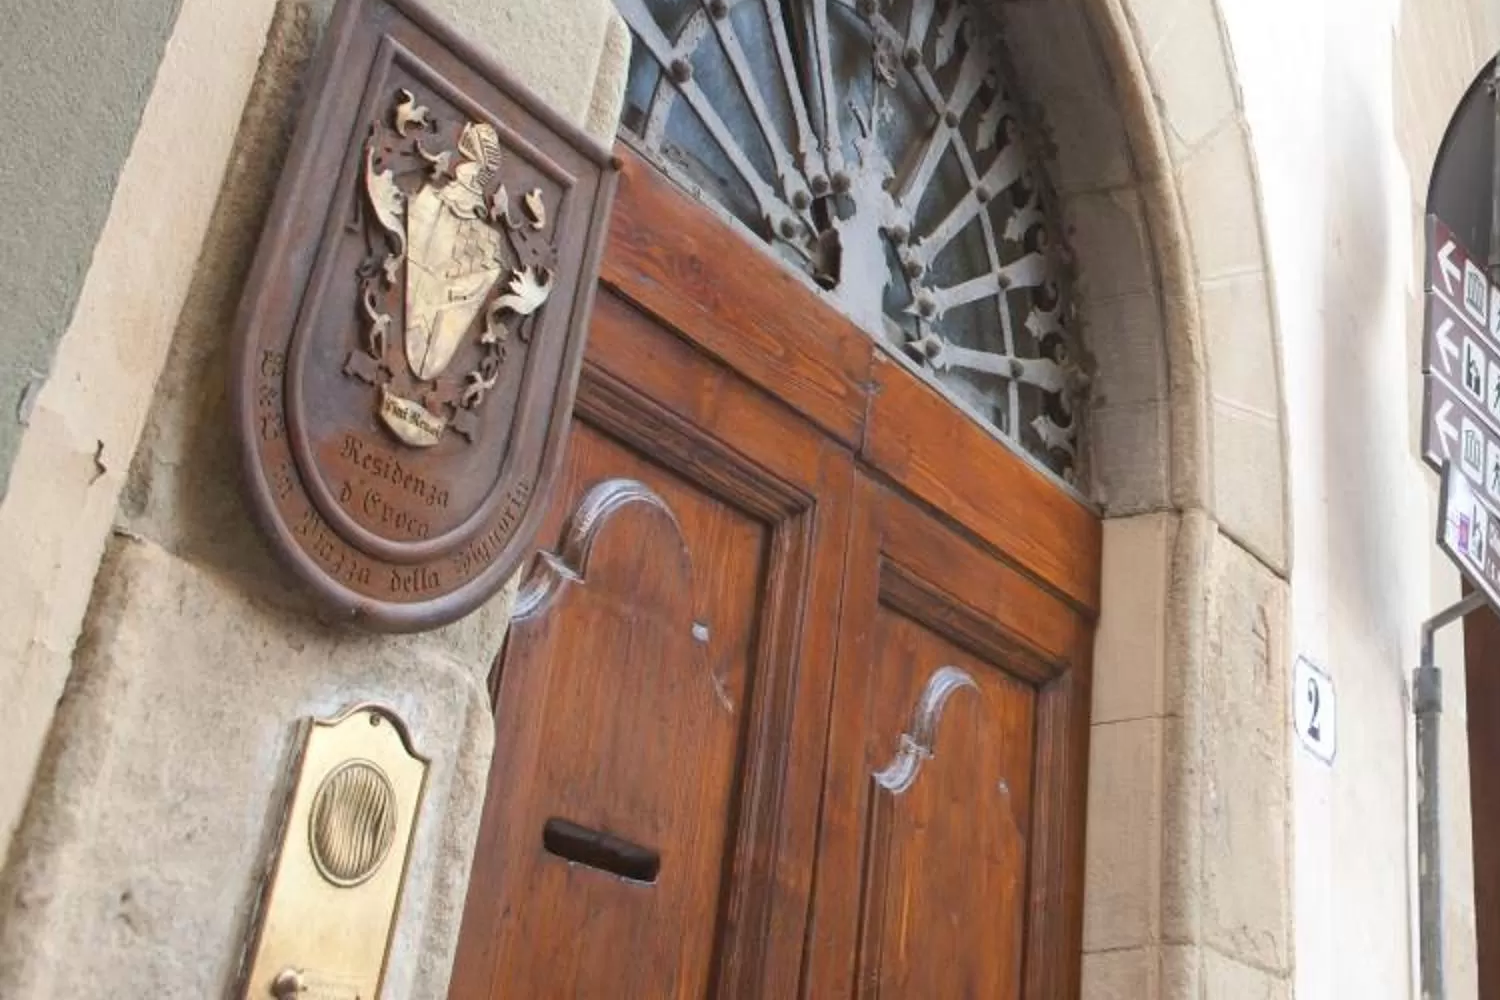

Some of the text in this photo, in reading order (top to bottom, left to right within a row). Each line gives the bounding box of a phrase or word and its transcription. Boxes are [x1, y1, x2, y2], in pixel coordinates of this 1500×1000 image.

[340, 434, 449, 510] Residenza
[390, 566, 441, 594] della
[454, 478, 530, 577] Signoria
[1306, 676, 1321, 742] 2
